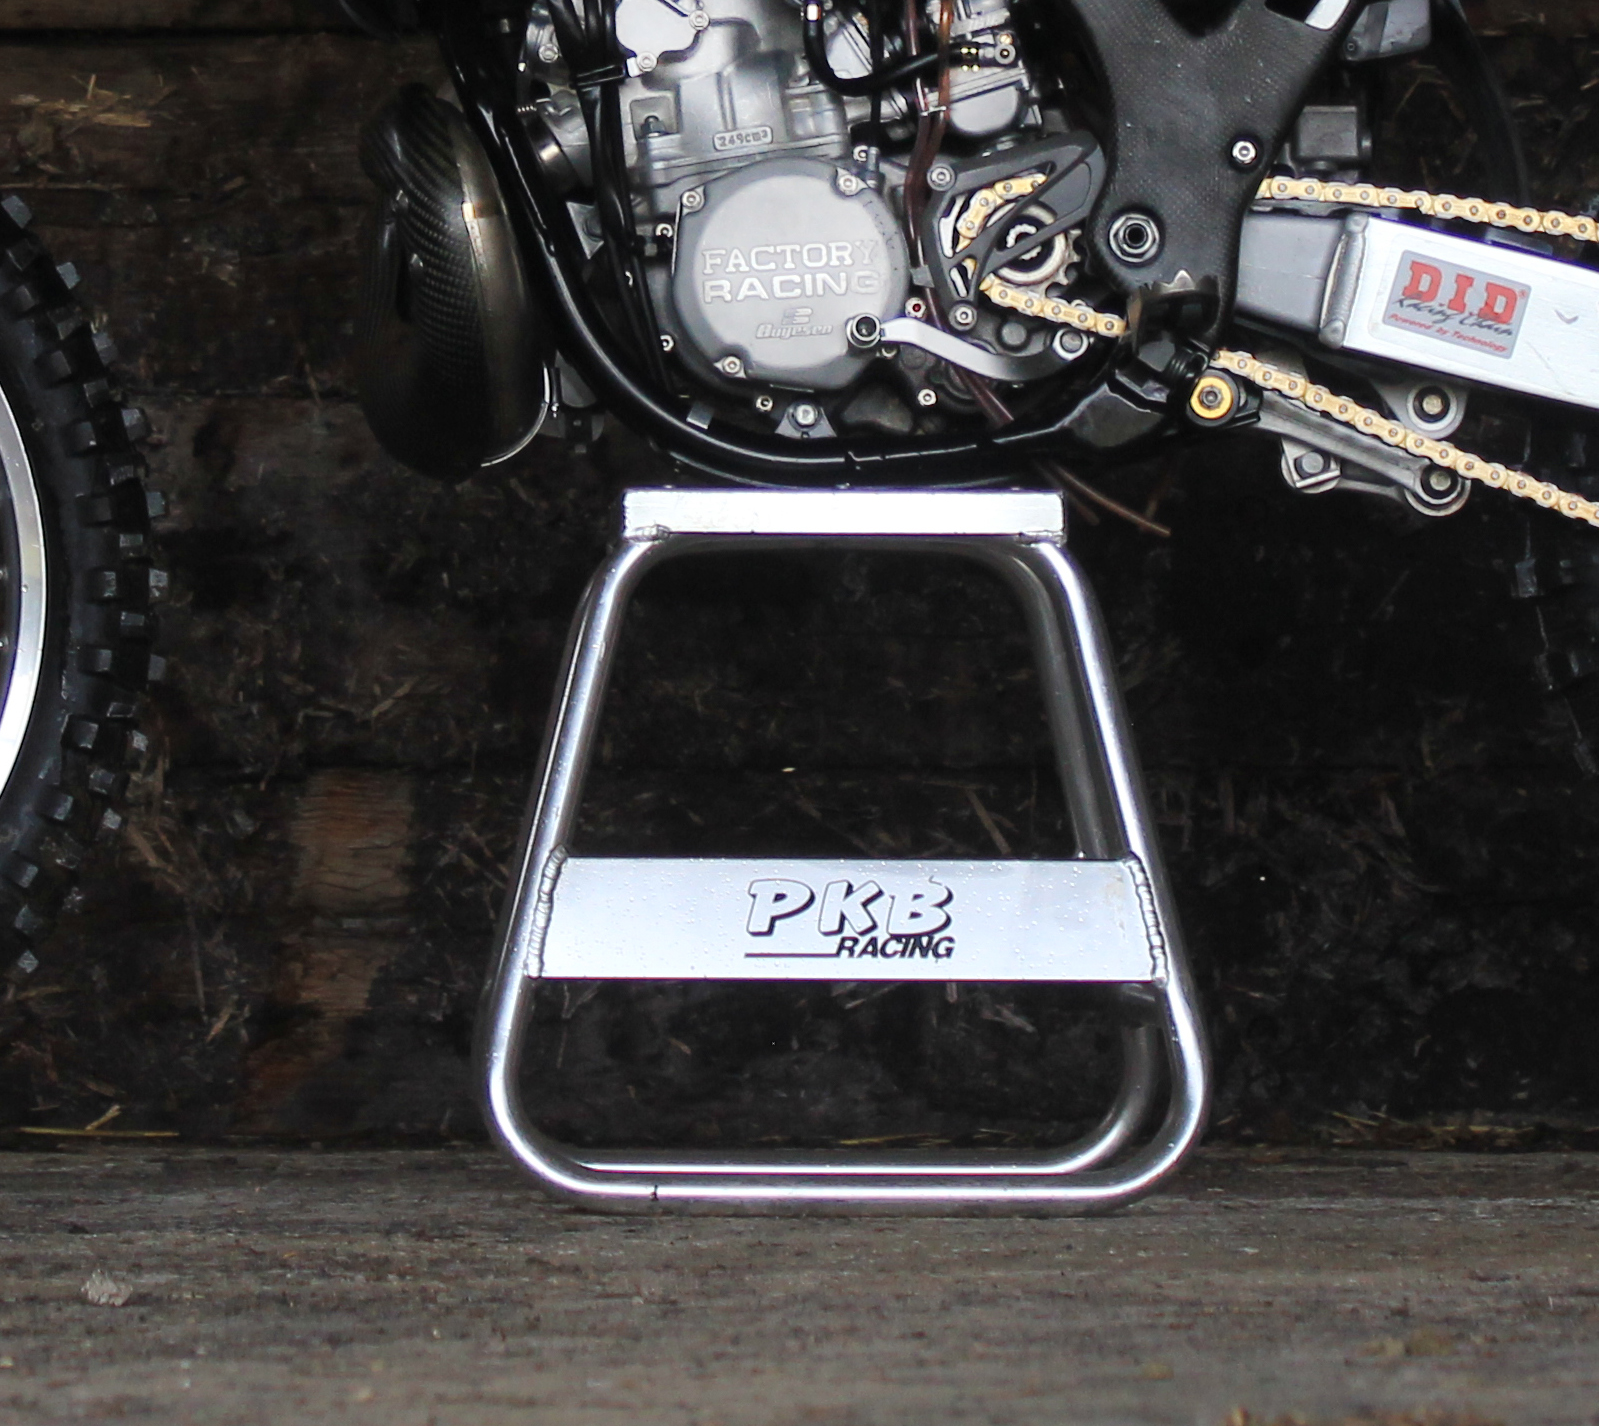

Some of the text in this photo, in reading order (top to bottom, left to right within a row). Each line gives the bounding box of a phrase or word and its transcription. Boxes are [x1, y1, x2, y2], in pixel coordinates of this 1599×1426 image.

[702, 239, 879, 274] FACTORY
[703, 270, 880, 303] RACING
[1388, 313, 1508, 353] Powered by Technology
[745, 876, 953, 937] PKB
[835, 935, 956, 960] RACING
